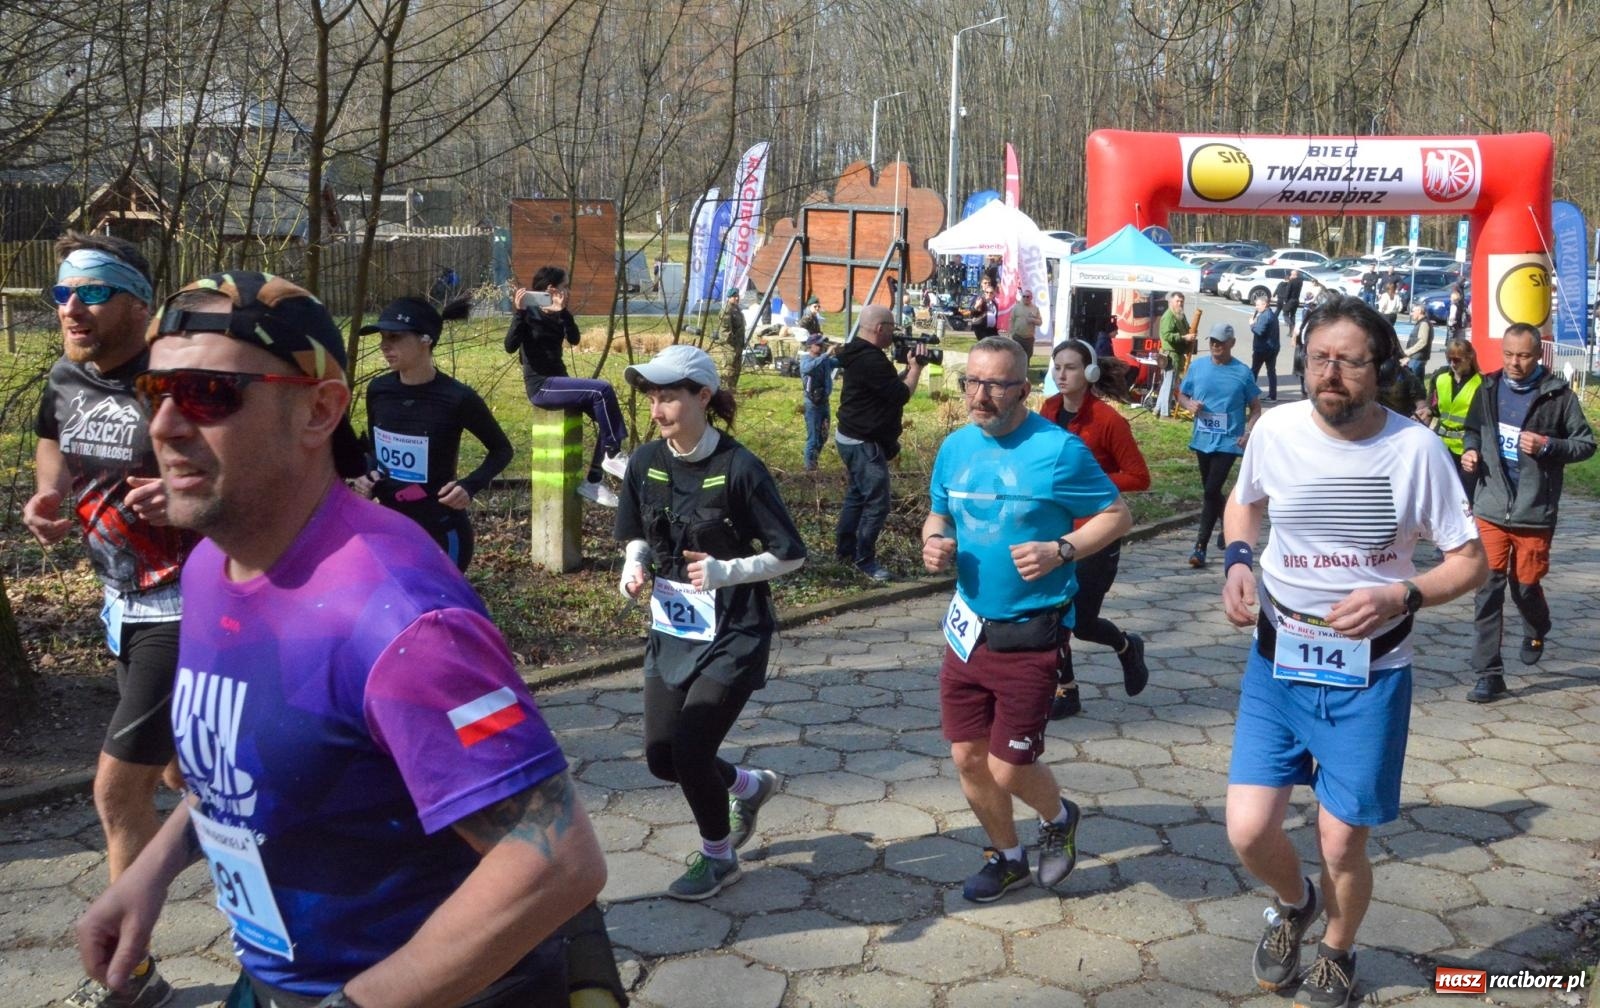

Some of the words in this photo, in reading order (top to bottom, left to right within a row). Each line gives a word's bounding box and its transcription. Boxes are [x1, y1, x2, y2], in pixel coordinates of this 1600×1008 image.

[1308, 146, 1358, 157] BIEG
[1267, 166, 1404, 182] TWARDZIELA
[1277, 187, 1388, 204] RACIBÓRZ
[1204, 419, 1220, 428] 128
[86, 420, 138, 446] SZCZYT
[381, 446, 416, 469] 050
[1283, 554, 1308, 568] BIEG
[1313, 552, 1360, 568] ZBÓJA
[1364, 551, 1398, 567] TEAM
[664, 600, 695, 624] 121
[1298, 643, 1346, 669] 114
